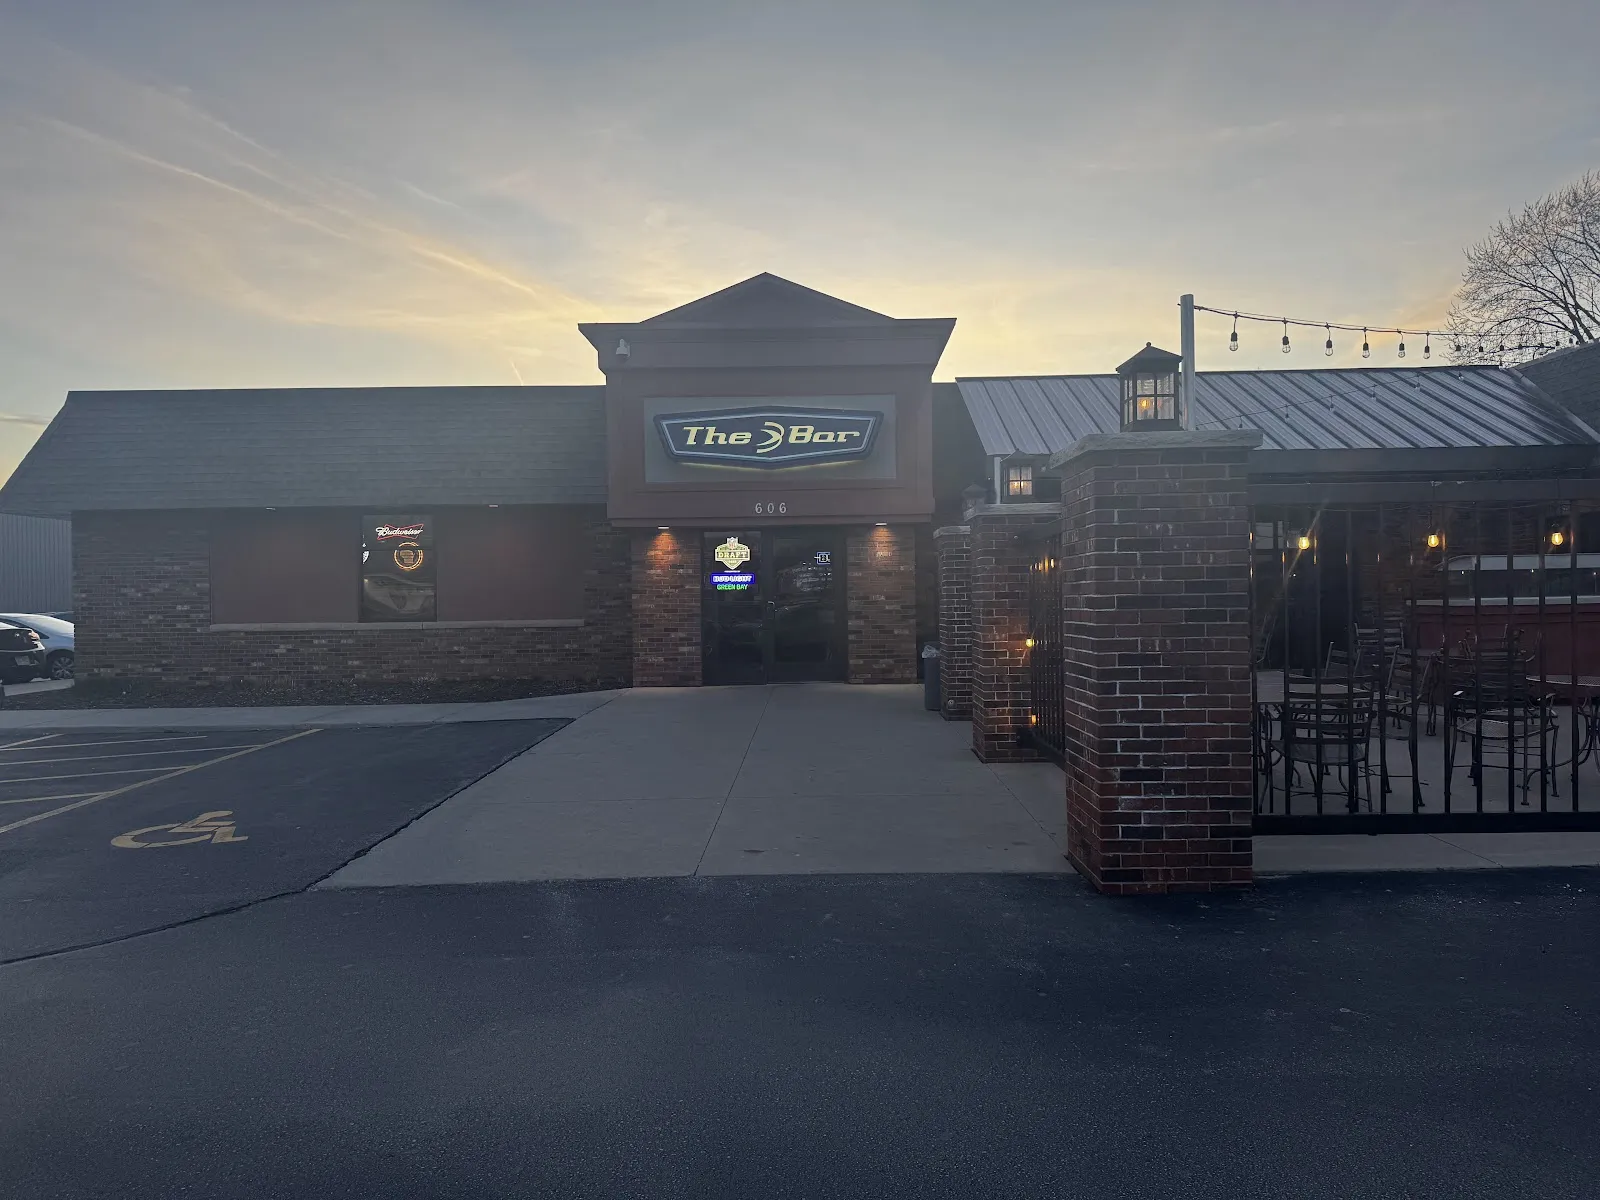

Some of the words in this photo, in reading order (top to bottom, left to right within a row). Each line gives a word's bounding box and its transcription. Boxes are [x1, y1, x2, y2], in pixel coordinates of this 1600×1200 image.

[683, 426, 752, 446] The
[788, 425, 861, 444] Bar
[755, 503, 787, 514] 606
[376, 527, 423, 536] Budweiser
